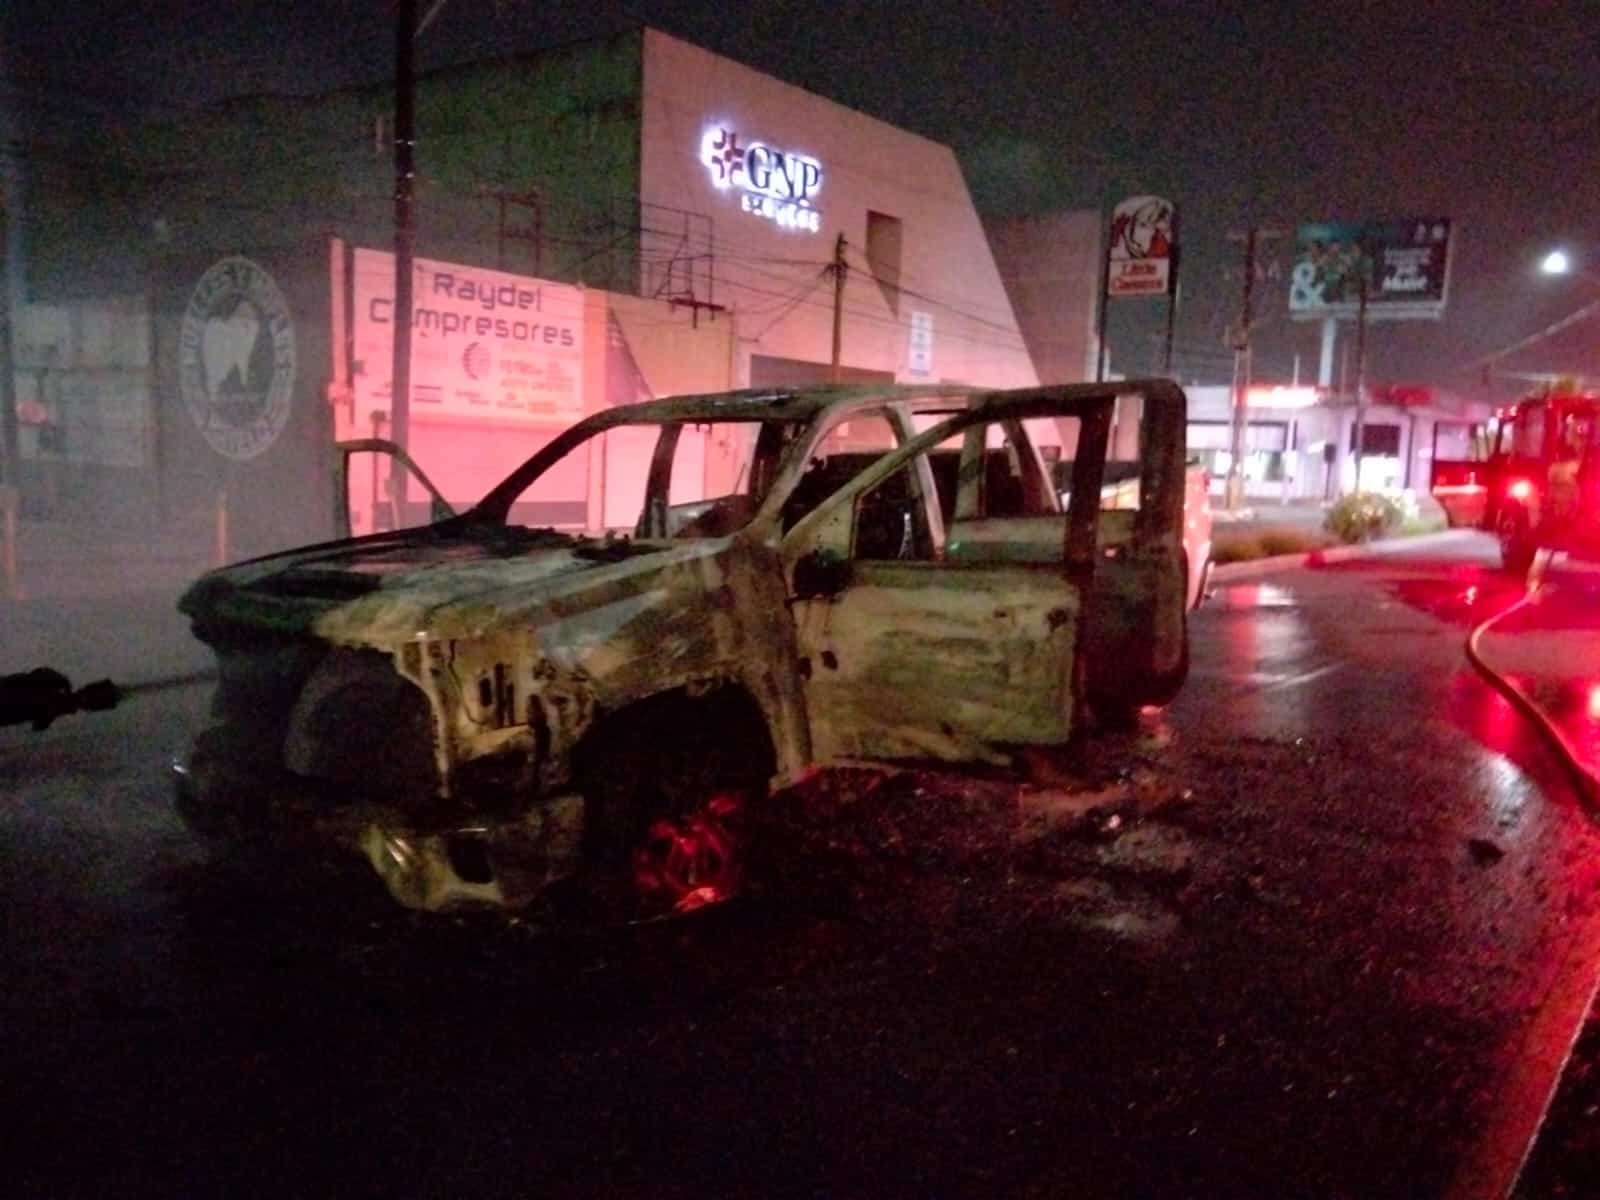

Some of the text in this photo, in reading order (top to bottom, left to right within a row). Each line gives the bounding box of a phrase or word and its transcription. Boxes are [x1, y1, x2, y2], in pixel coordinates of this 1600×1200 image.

[746, 145, 820, 201] GNP
[433, 272, 542, 313] Raydel
[369, 297, 575, 346] Cmpresores
